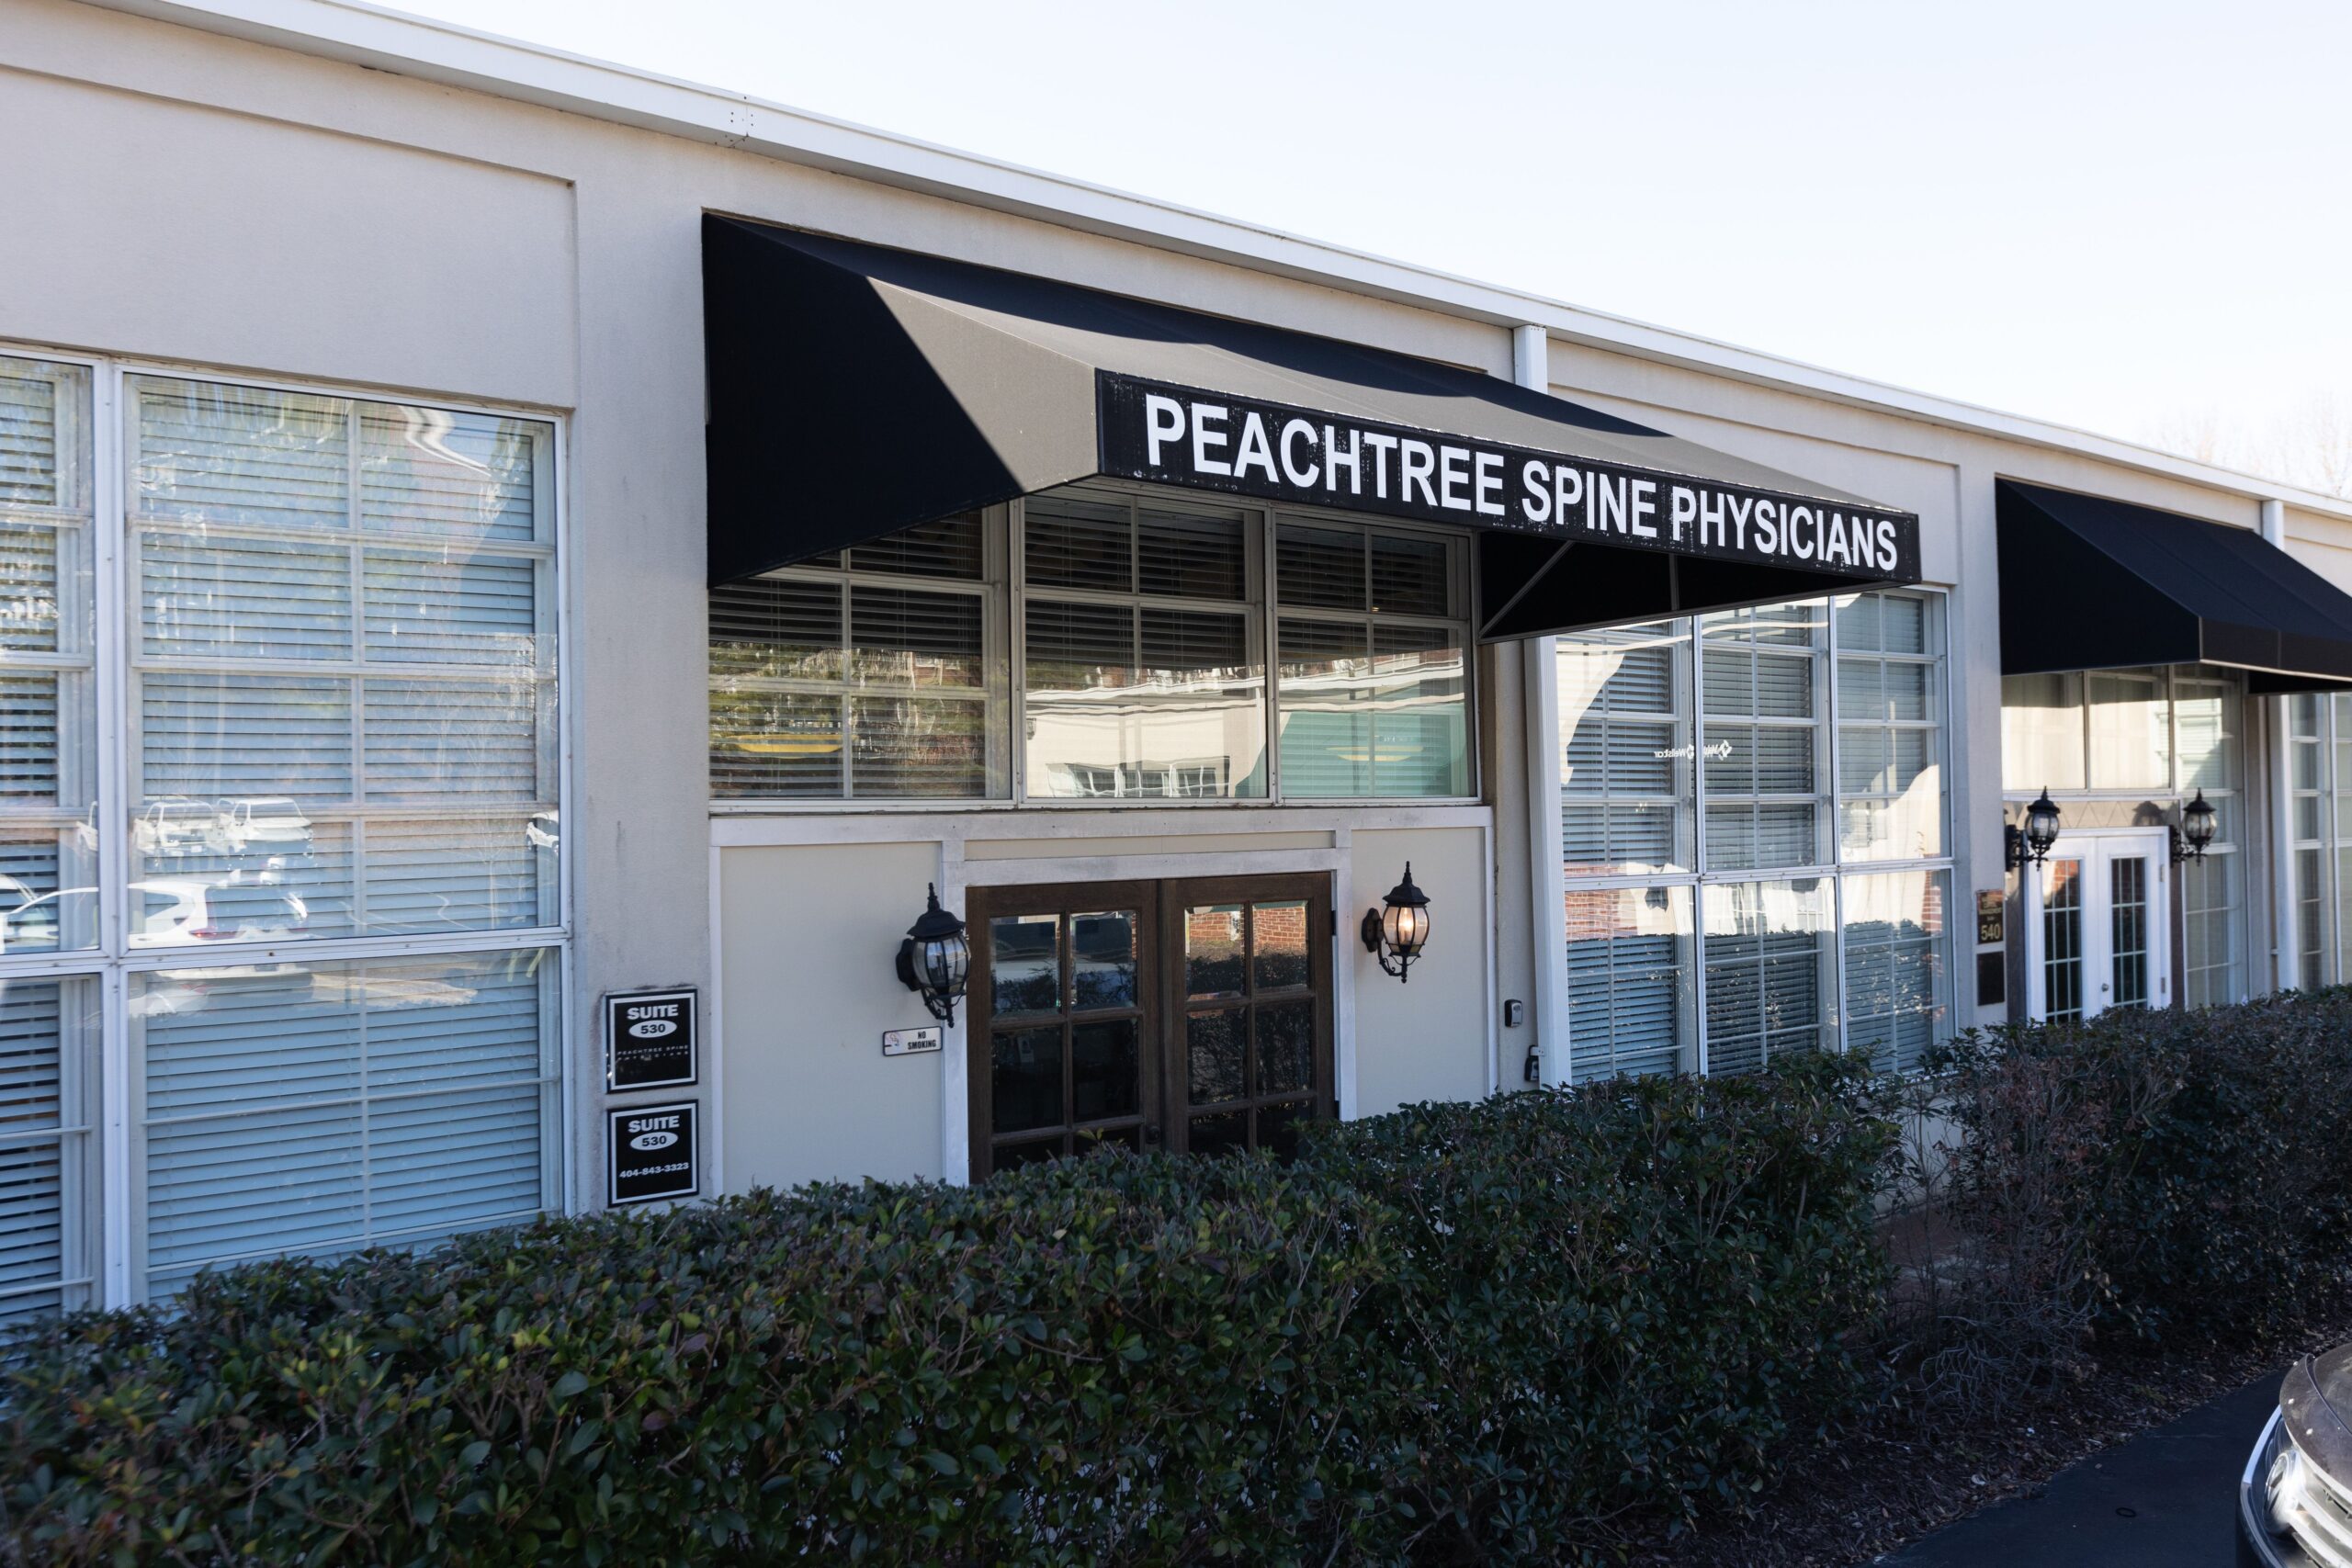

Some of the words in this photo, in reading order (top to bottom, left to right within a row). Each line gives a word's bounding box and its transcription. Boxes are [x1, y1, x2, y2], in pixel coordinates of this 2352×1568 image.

[1145, 393, 1506, 516] PEACHTREE
[1521, 459, 1657, 538] SPINE
[1672, 485, 1898, 571] PHYSICIANS
[1981, 922, 2002, 941] 540
[627, 1004, 679, 1020] SUITE
[640, 1023, 666, 1034] 530
[917, 1031, 926, 1039] NO
[907, 1039, 936, 1050] SMOKING
[628, 1115, 680, 1134] SUITE
[641, 1135, 667, 1146] 530
[619, 1162, 690, 1179] 404-843-3323
